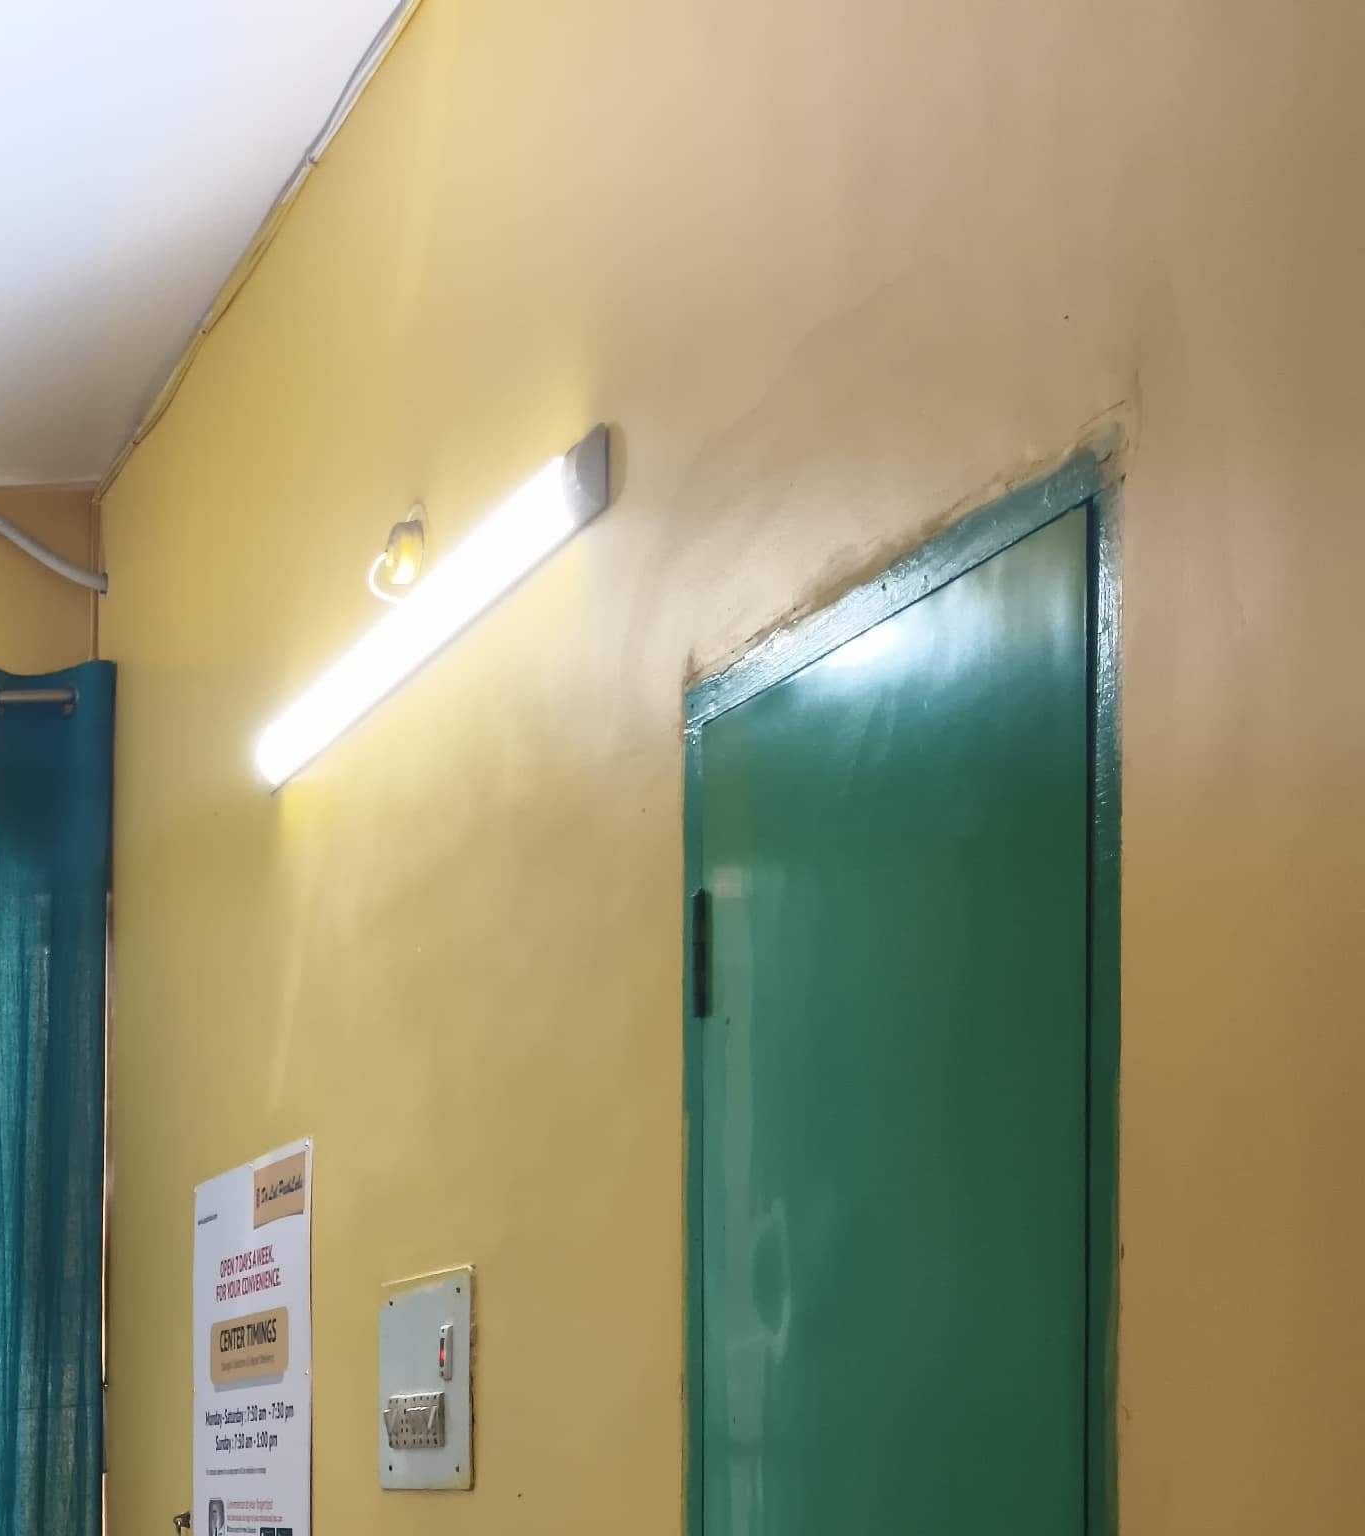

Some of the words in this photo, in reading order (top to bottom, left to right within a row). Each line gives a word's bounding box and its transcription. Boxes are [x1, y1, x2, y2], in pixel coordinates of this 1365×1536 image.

[220, 1257, 235, 1278] OPEN
[239, 1251, 252, 1272] DAYS
[216, 1283, 227, 1302] FOR
[227, 1279, 241, 1299] YOUR
[219, 1326, 245, 1352] CENTER
[246, 1318, 277, 1346] TIMINGS
[259, 1408, 266, 1421] am
[285, 1405, 294, 1422] pm
[245, 1436, 253, 1448] am
[269, 1434, 277, 1452] pm
